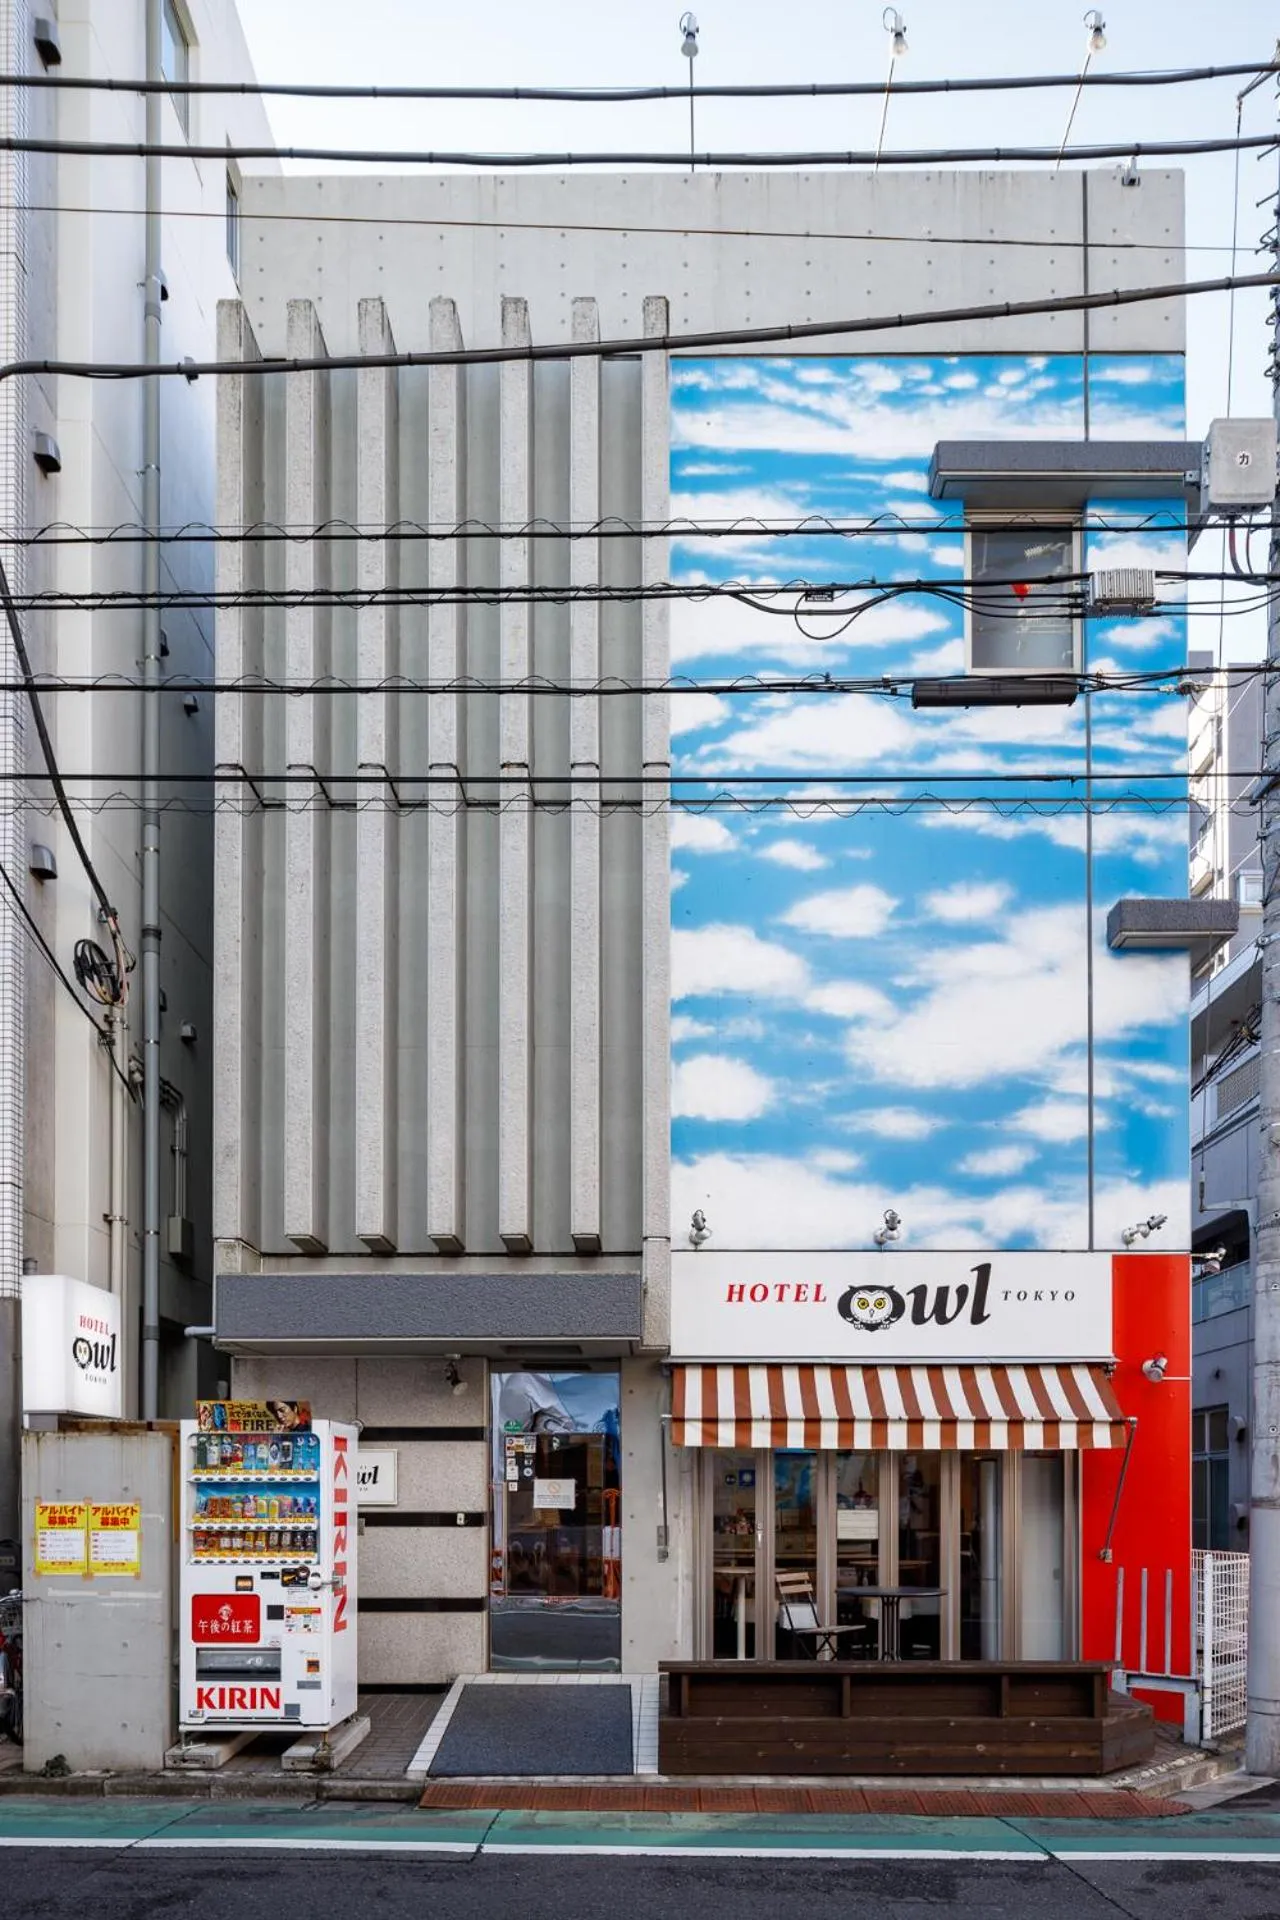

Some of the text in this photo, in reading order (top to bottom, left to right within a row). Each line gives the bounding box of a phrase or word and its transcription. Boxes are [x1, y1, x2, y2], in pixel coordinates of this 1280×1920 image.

[726, 1262, 1076, 1332] HOTEL Owl TOKYO
[79, 1315, 109, 1336] HOTEL
[72, 1333, 116, 1372] Owl
[242, 1420, 273, 1432] FIRE
[356, 1465, 379, 1485] wl
[39, 1505, 85, 1515] アルバイト
[92, 1506, 138, 1516] アルバイト
[48, 1516, 77, 1526] 募集中
[100, 1517, 130, 1527] 募集中
[333, 1436, 348, 1633] KIRIN
[198, 1620, 253, 1634] 午後の紅茶
[196, 1687, 280, 1709] KIRIN
